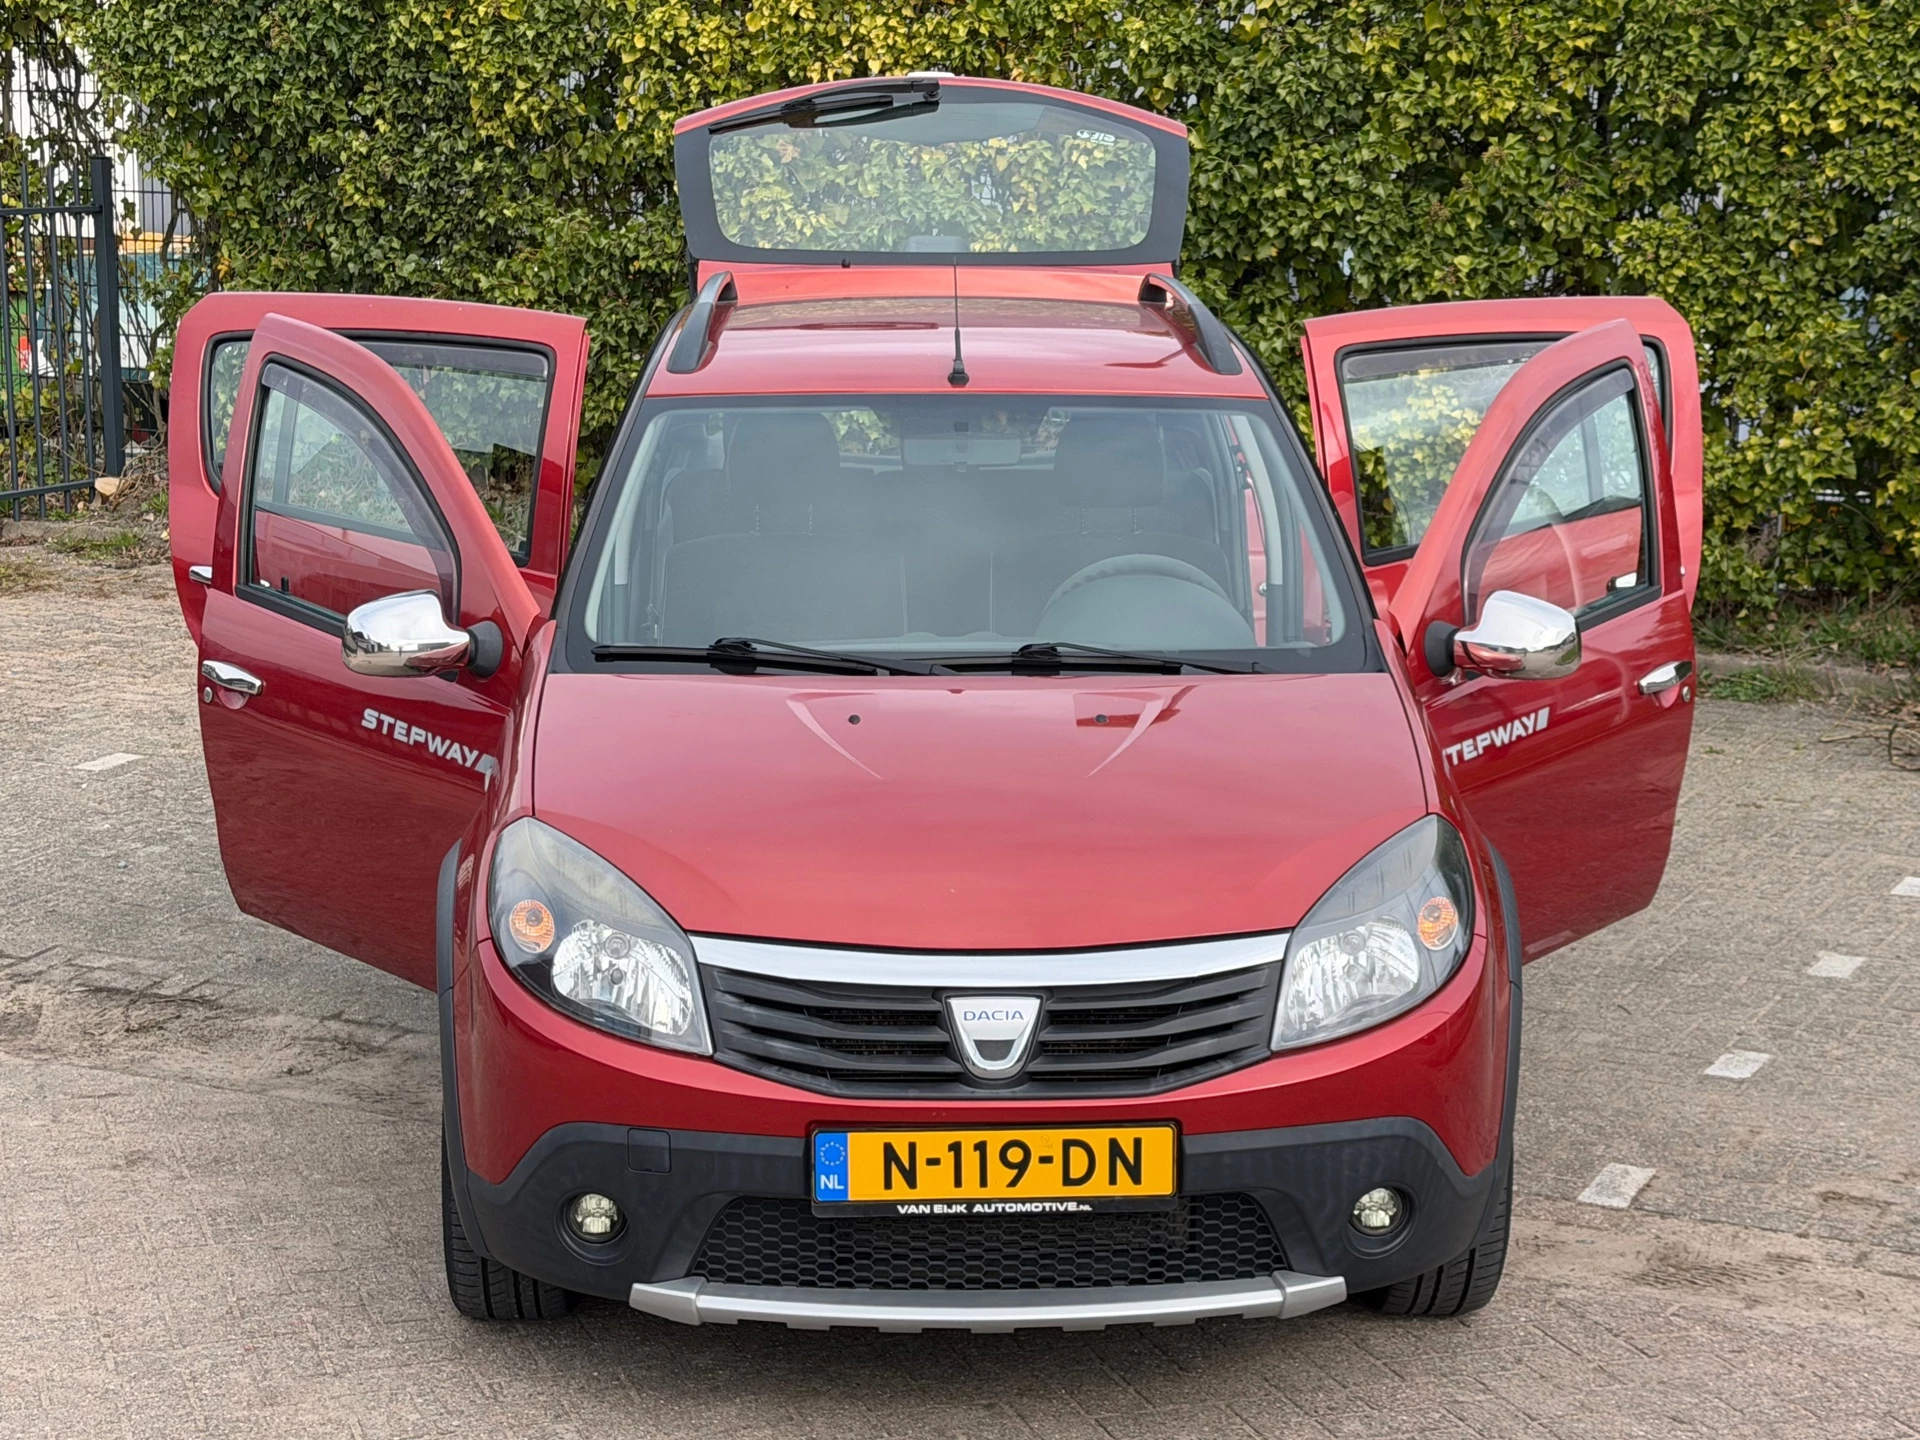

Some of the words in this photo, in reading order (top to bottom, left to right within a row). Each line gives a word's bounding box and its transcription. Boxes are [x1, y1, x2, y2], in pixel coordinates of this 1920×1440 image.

[361, 708, 479, 768] STEPWAY
[1443, 712, 1536, 768] TEPWAY
[963, 1010, 1024, 1021] DACIA
[883, 1137, 1143, 1190] N-119-DN
[820, 1174, 845, 1190] NL
[896, 1204, 931, 1214] VAN
[933, 1203, 968, 1214] EIJK
